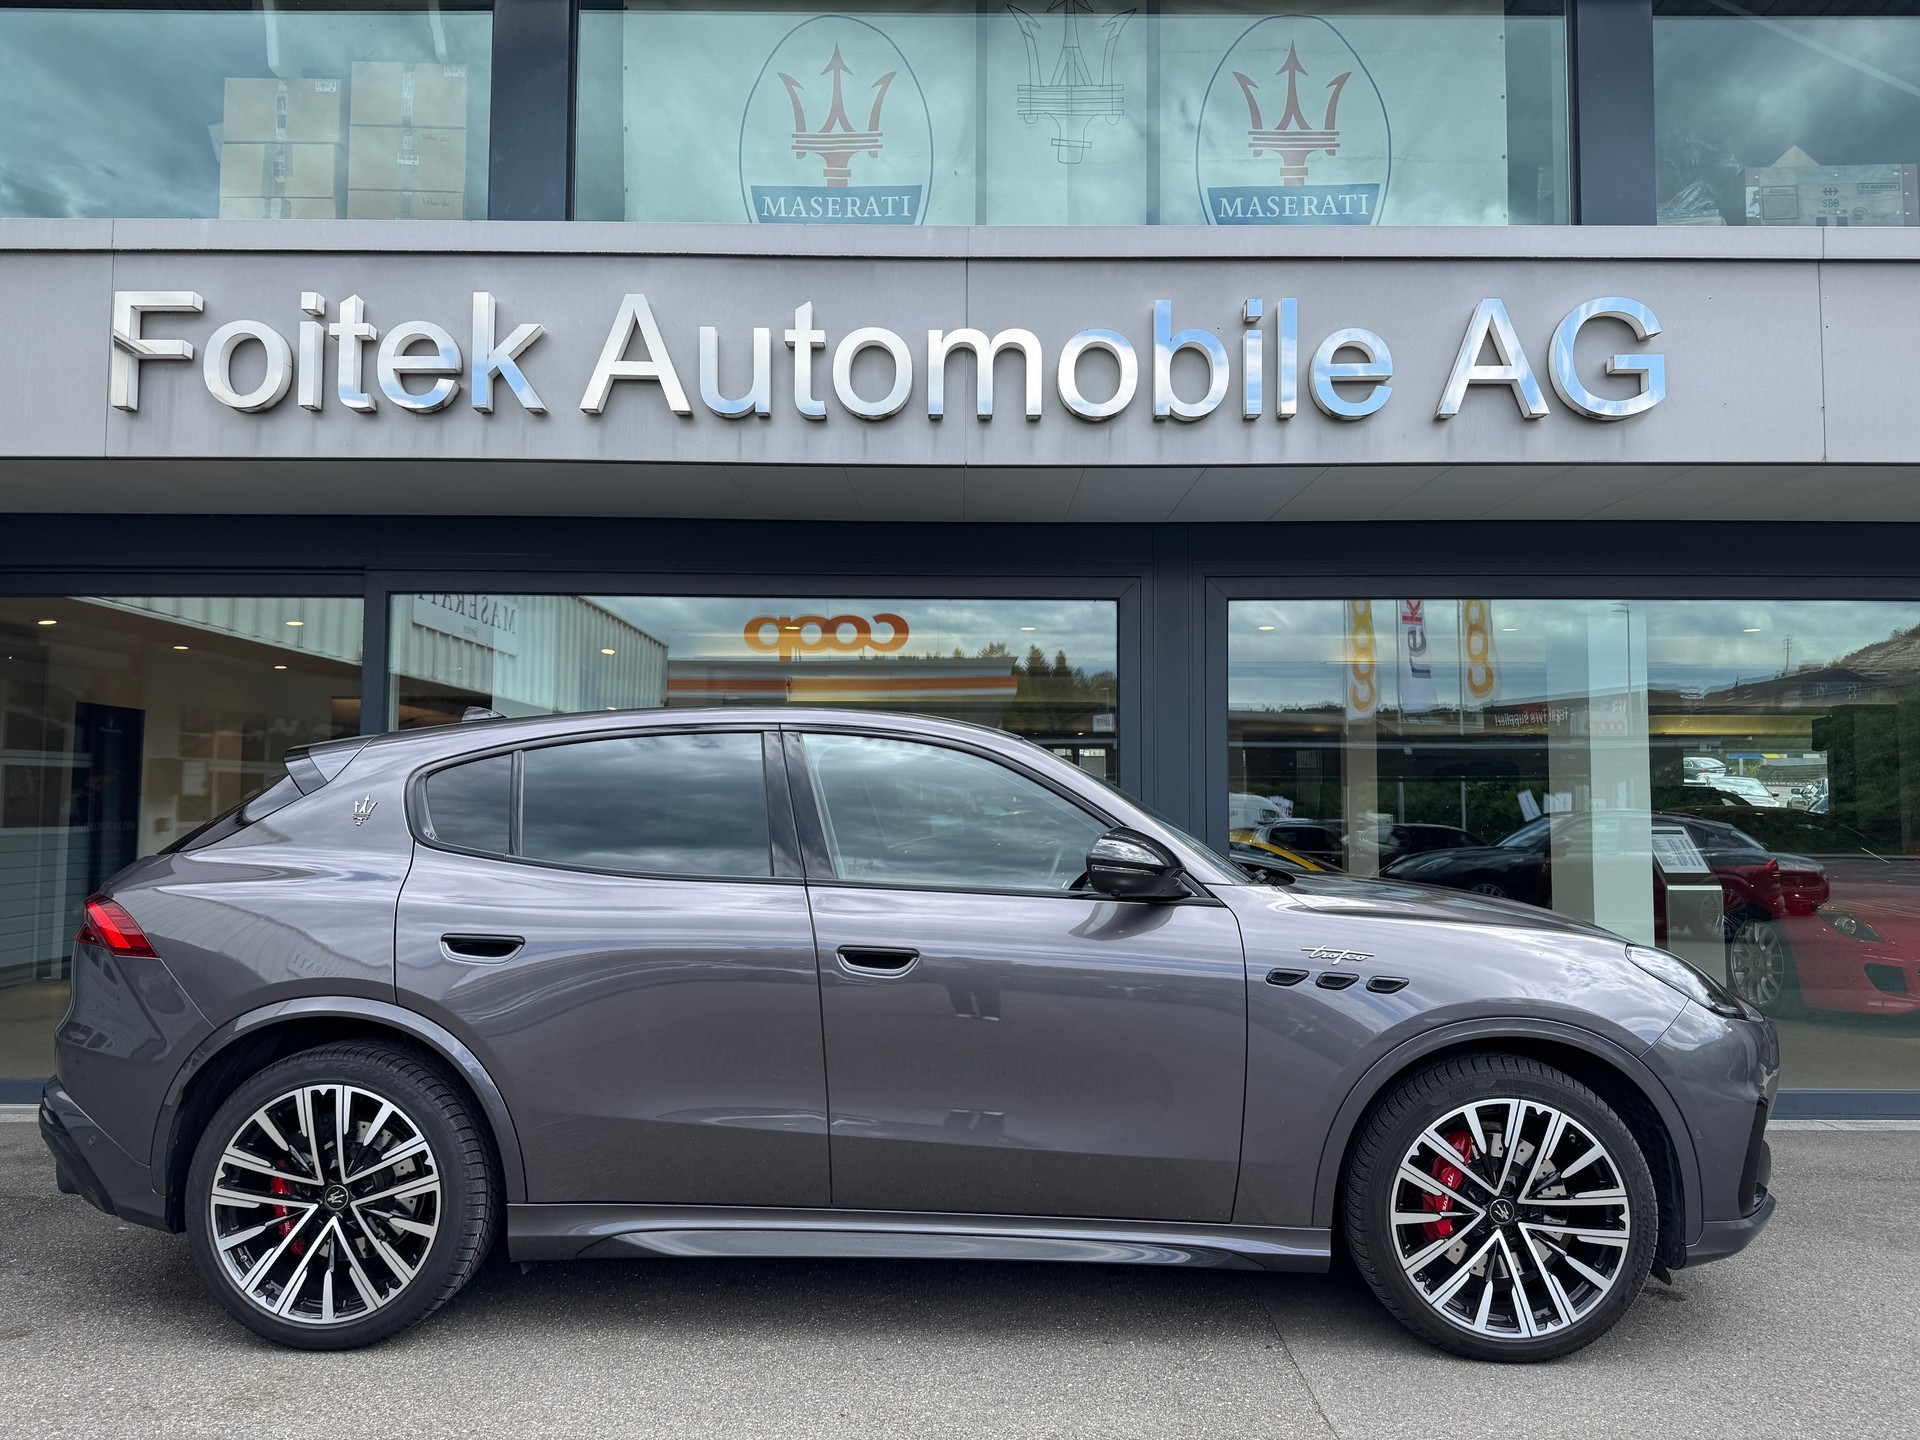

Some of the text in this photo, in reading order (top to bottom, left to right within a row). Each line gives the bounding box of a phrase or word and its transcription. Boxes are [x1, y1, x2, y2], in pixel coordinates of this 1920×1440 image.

[761, 195, 912, 218] MASERATI
[1218, 194, 1369, 218] MASERATI
[1822, 198, 1840, 208] SBB
[111, 291, 1666, 421] Foitek Automobile AG
[1301, 945, 1376, 966] trofeo
